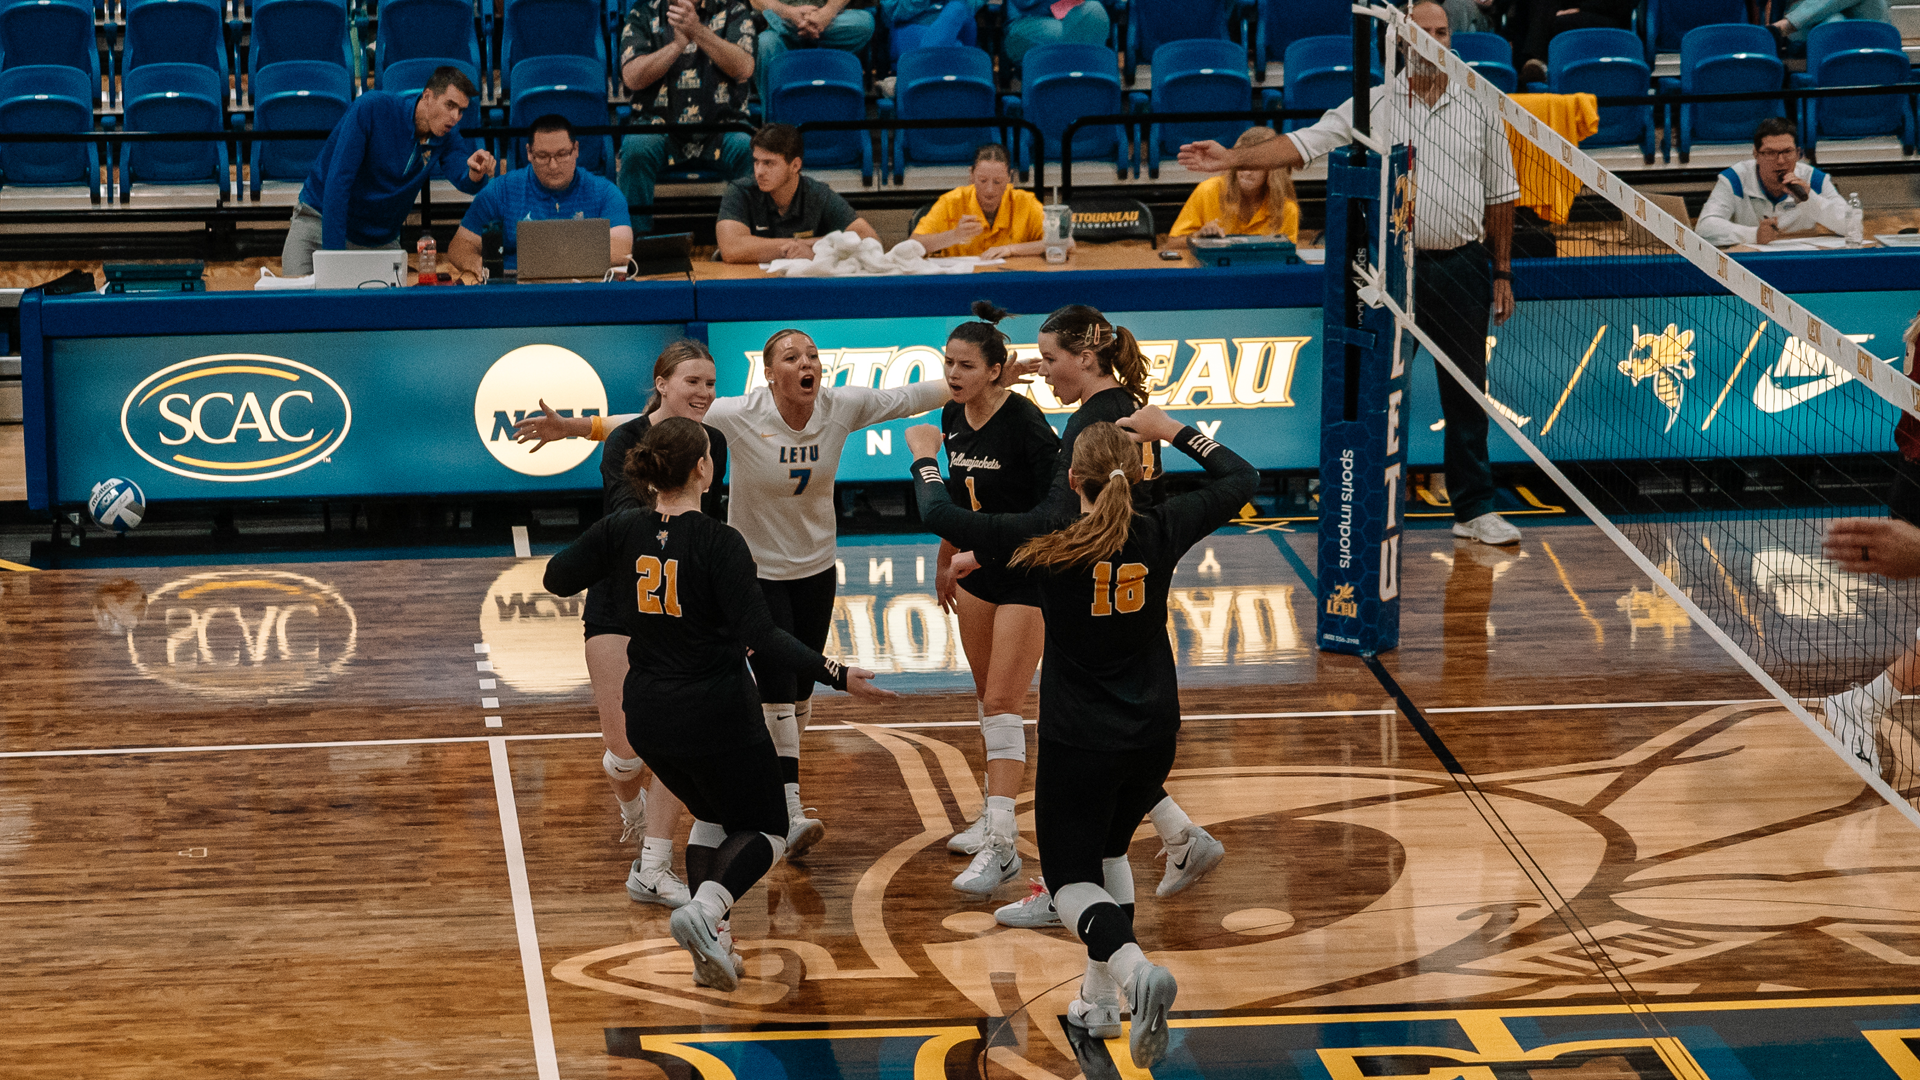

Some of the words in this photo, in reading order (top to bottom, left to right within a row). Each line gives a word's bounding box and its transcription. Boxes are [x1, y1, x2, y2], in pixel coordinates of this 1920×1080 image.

[158, 390, 314, 445] SCAC
[779, 444, 820, 464] LETU
[949, 451, 1002, 472] Yellowjackets
[788, 467, 813, 497] 7
[1339, 449, 1354, 502] sports
[91, 481, 115, 507] molten
[964, 476, 982, 512] 1
[1338, 503, 1353, 569] imports
[636, 554, 683, 618] 21
[1091, 560, 1149, 616] 18
[1326, 598, 1358, 619] LETU
